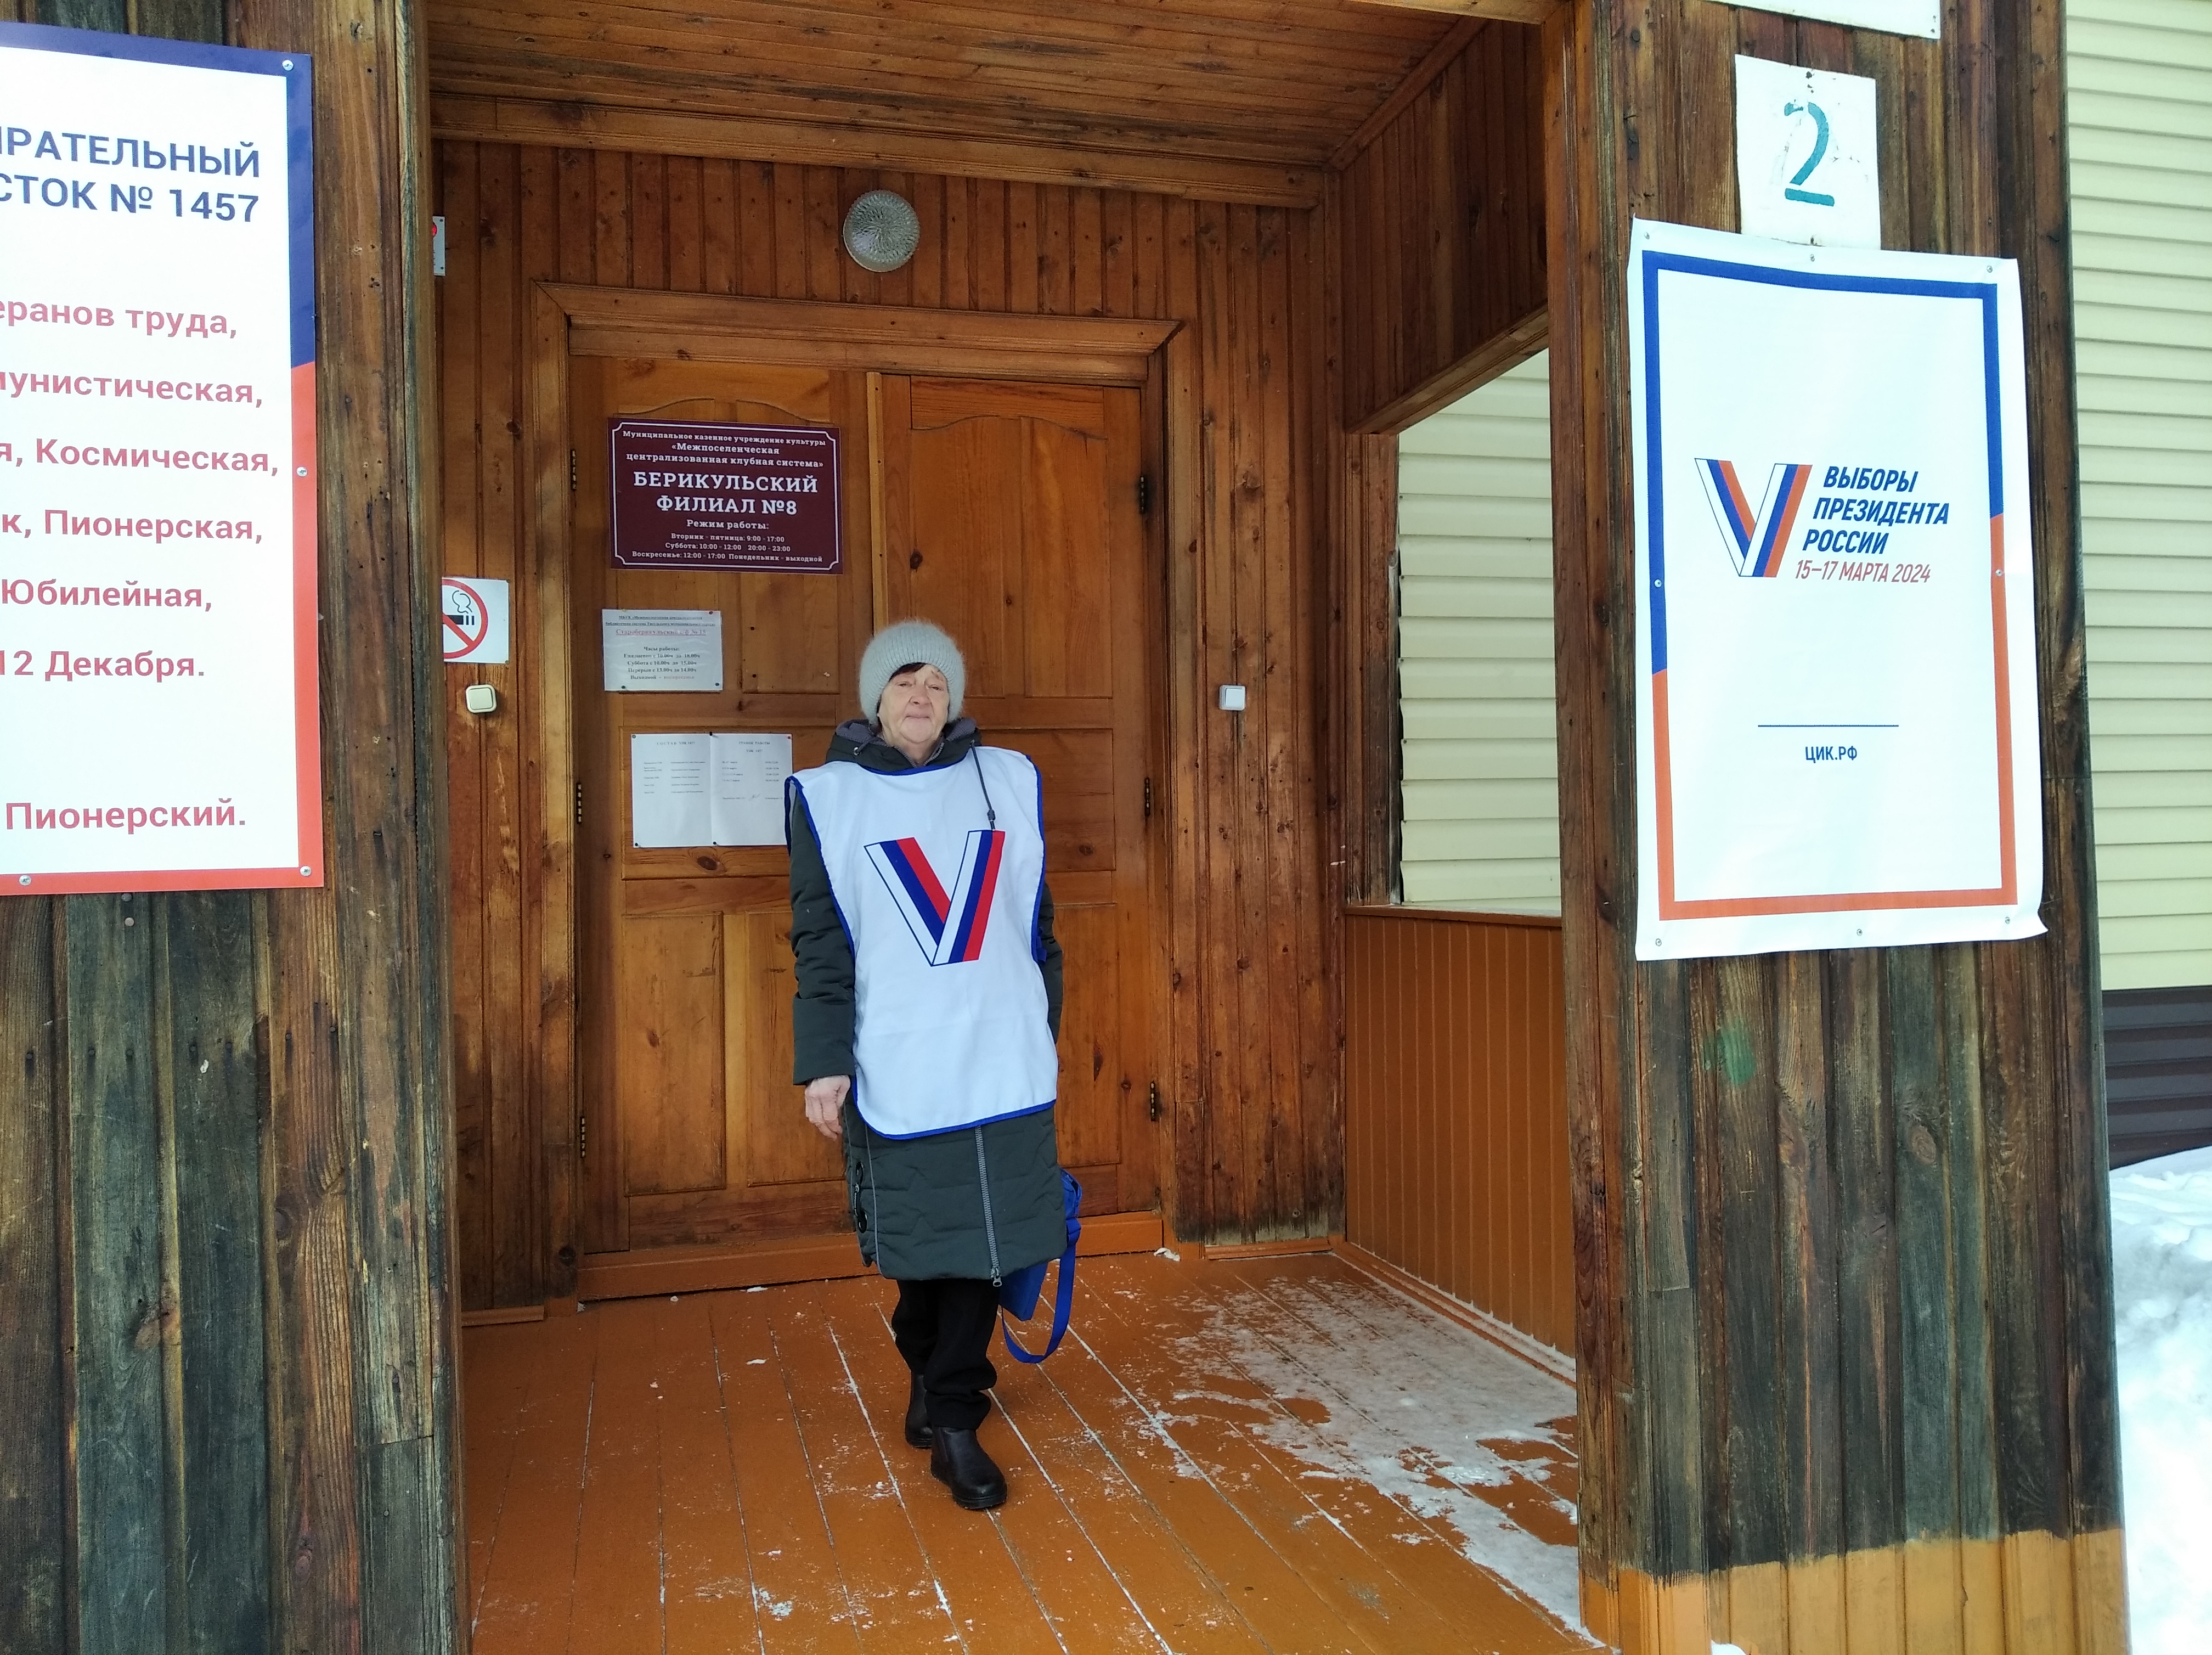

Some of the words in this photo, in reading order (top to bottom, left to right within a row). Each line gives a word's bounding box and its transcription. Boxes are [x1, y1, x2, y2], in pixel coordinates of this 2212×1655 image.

[0, 126, 260, 178] РАТЕЛЬНЫЙ
[1784, 102, 1835, 207] 2
[111, 184, 153, 213] №
[170, 189, 259, 222] 1457
[0, 301, 114, 327] ранов
[125, 308, 237, 339] труда,
[0, 371, 263, 408] унистическая,
[623, 431, 693, 439] Муниципальное
[672, 442, 780, 454] «Межпоселенческая
[36, 438, 279, 476] Космическая,
[626, 453, 727, 464] централизованная
[730, 457, 774, 466] клубная
[634, 471, 818, 493] БЕРИКУЛЬСКИЙ
[1823, 466, 1918, 493] ВЫБОРЫ
[657, 494, 756, 514] ФИЛИАЛ
[761, 499, 797, 515] №8
[1813, 497, 1950, 526] ПРЕЗИДЕНТА
[2, 514, 31, 539] к,
[45, 509, 263, 544] Пионерская,
[686, 519, 725, 528] Режим
[727, 521, 769, 530] работы:
[1802, 529, 1889, 555] РОССИИ
[1838, 561, 1888, 583] МАРТА
[1891, 563, 1931, 583] 2024
[2, 579, 212, 612] Юбилейная,
[45, 650, 205, 682] Декабря.
[1805, 746, 1858, 764] ЦИК.РФ
[6, 798, 246, 834] Пионерский.
